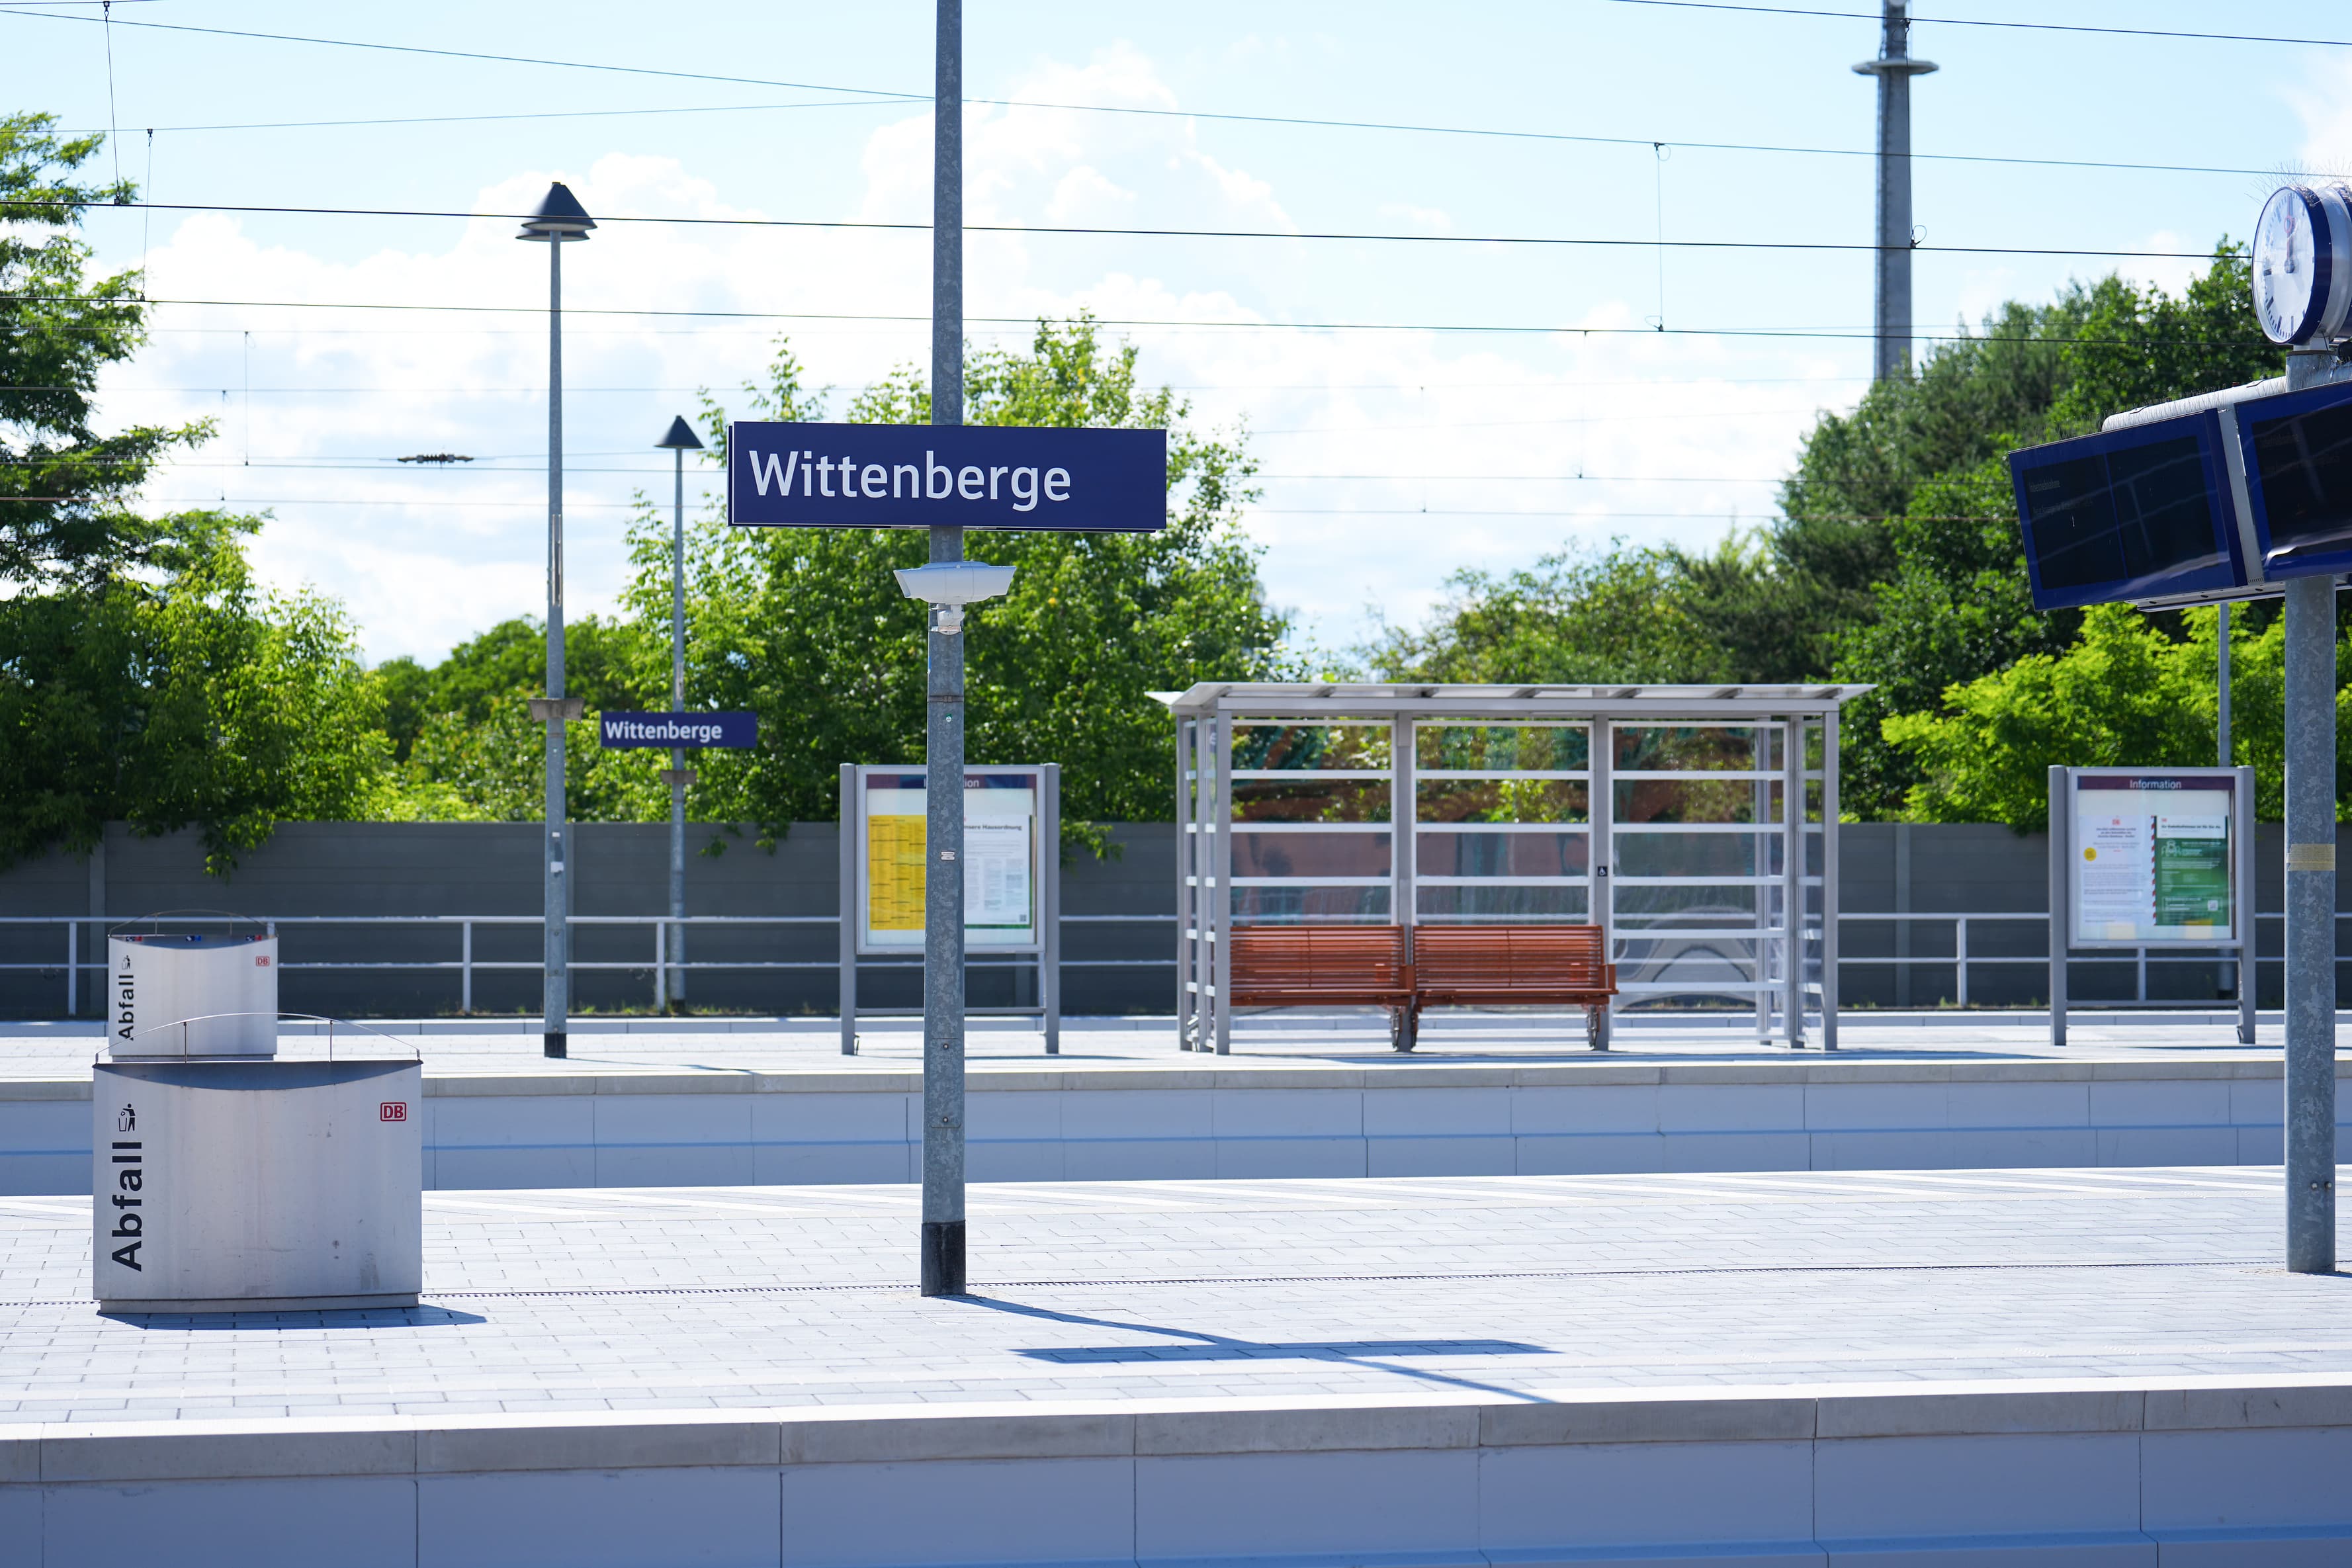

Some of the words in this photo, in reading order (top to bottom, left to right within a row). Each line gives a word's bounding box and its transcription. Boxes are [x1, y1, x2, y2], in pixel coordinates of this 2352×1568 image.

[749, 450, 1071, 511] Wittenberge
[605, 720, 722, 743] Wittenberge
[2129, 779, 2182, 789] Information
[257, 957, 269, 966] DB
[118, 975, 134, 1041] Abfall
[383, 1105, 404, 1119] DB
[112, 1141, 142, 1272] Abfall
